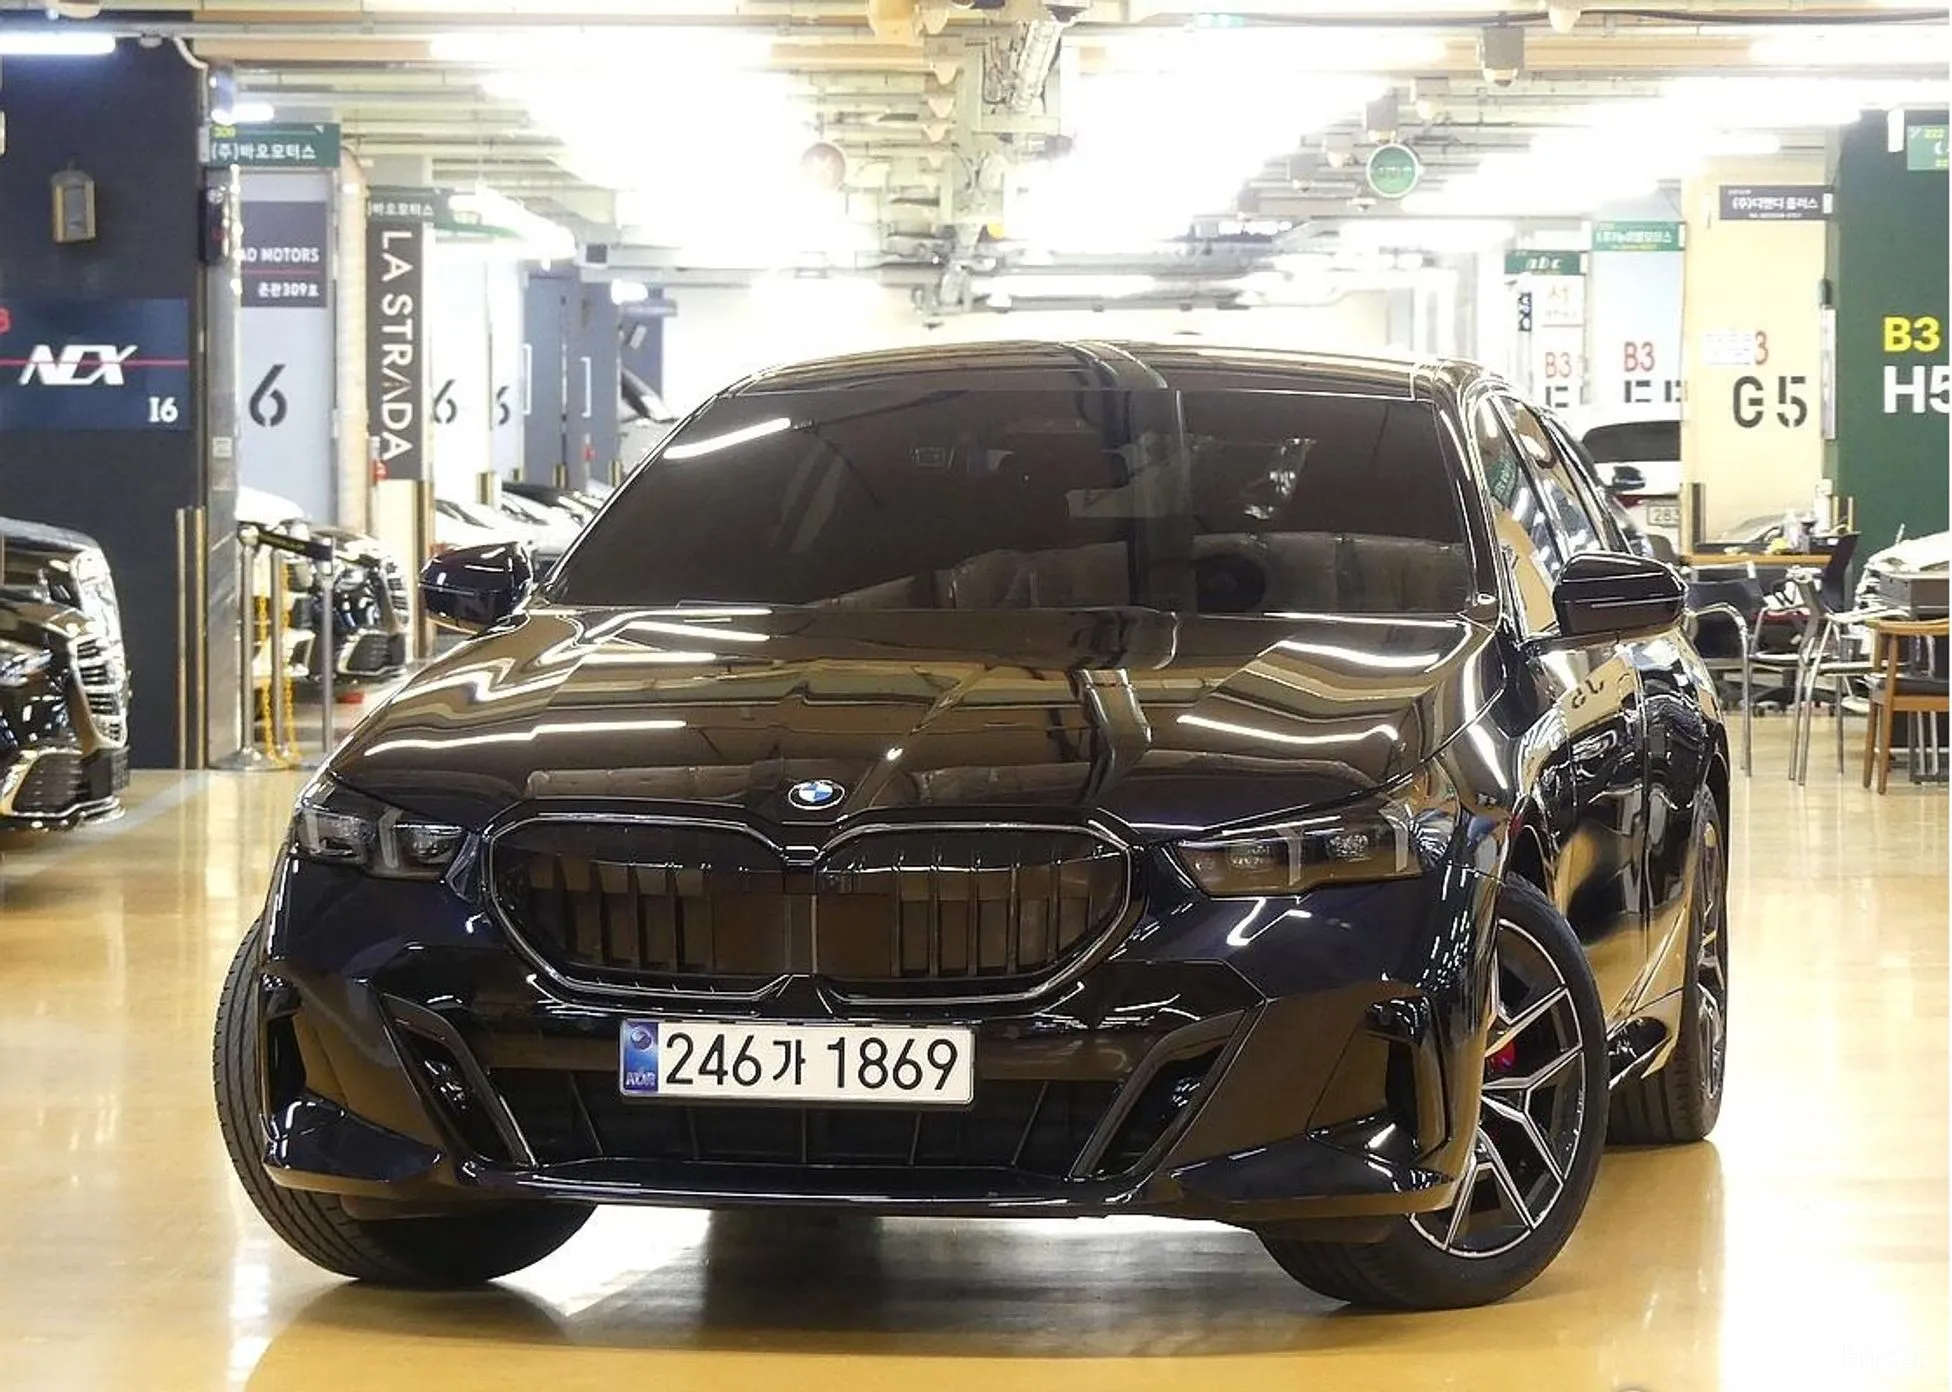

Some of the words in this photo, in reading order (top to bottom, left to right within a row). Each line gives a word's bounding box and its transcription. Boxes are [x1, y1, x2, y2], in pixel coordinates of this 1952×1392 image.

[261, 247, 320, 263] MOTORS
[381, 231, 414, 282] LA
[1884, 316, 1940, 352] B3
[381, 293, 413, 461] STRADA
[1545, 352, 1572, 378] B3
[1623, 341, 1655, 372] B3
[1733, 375, 1808, 428] G5
[665, 1031, 806, 1087] 246가
[826, 1036, 959, 1091] 1869
